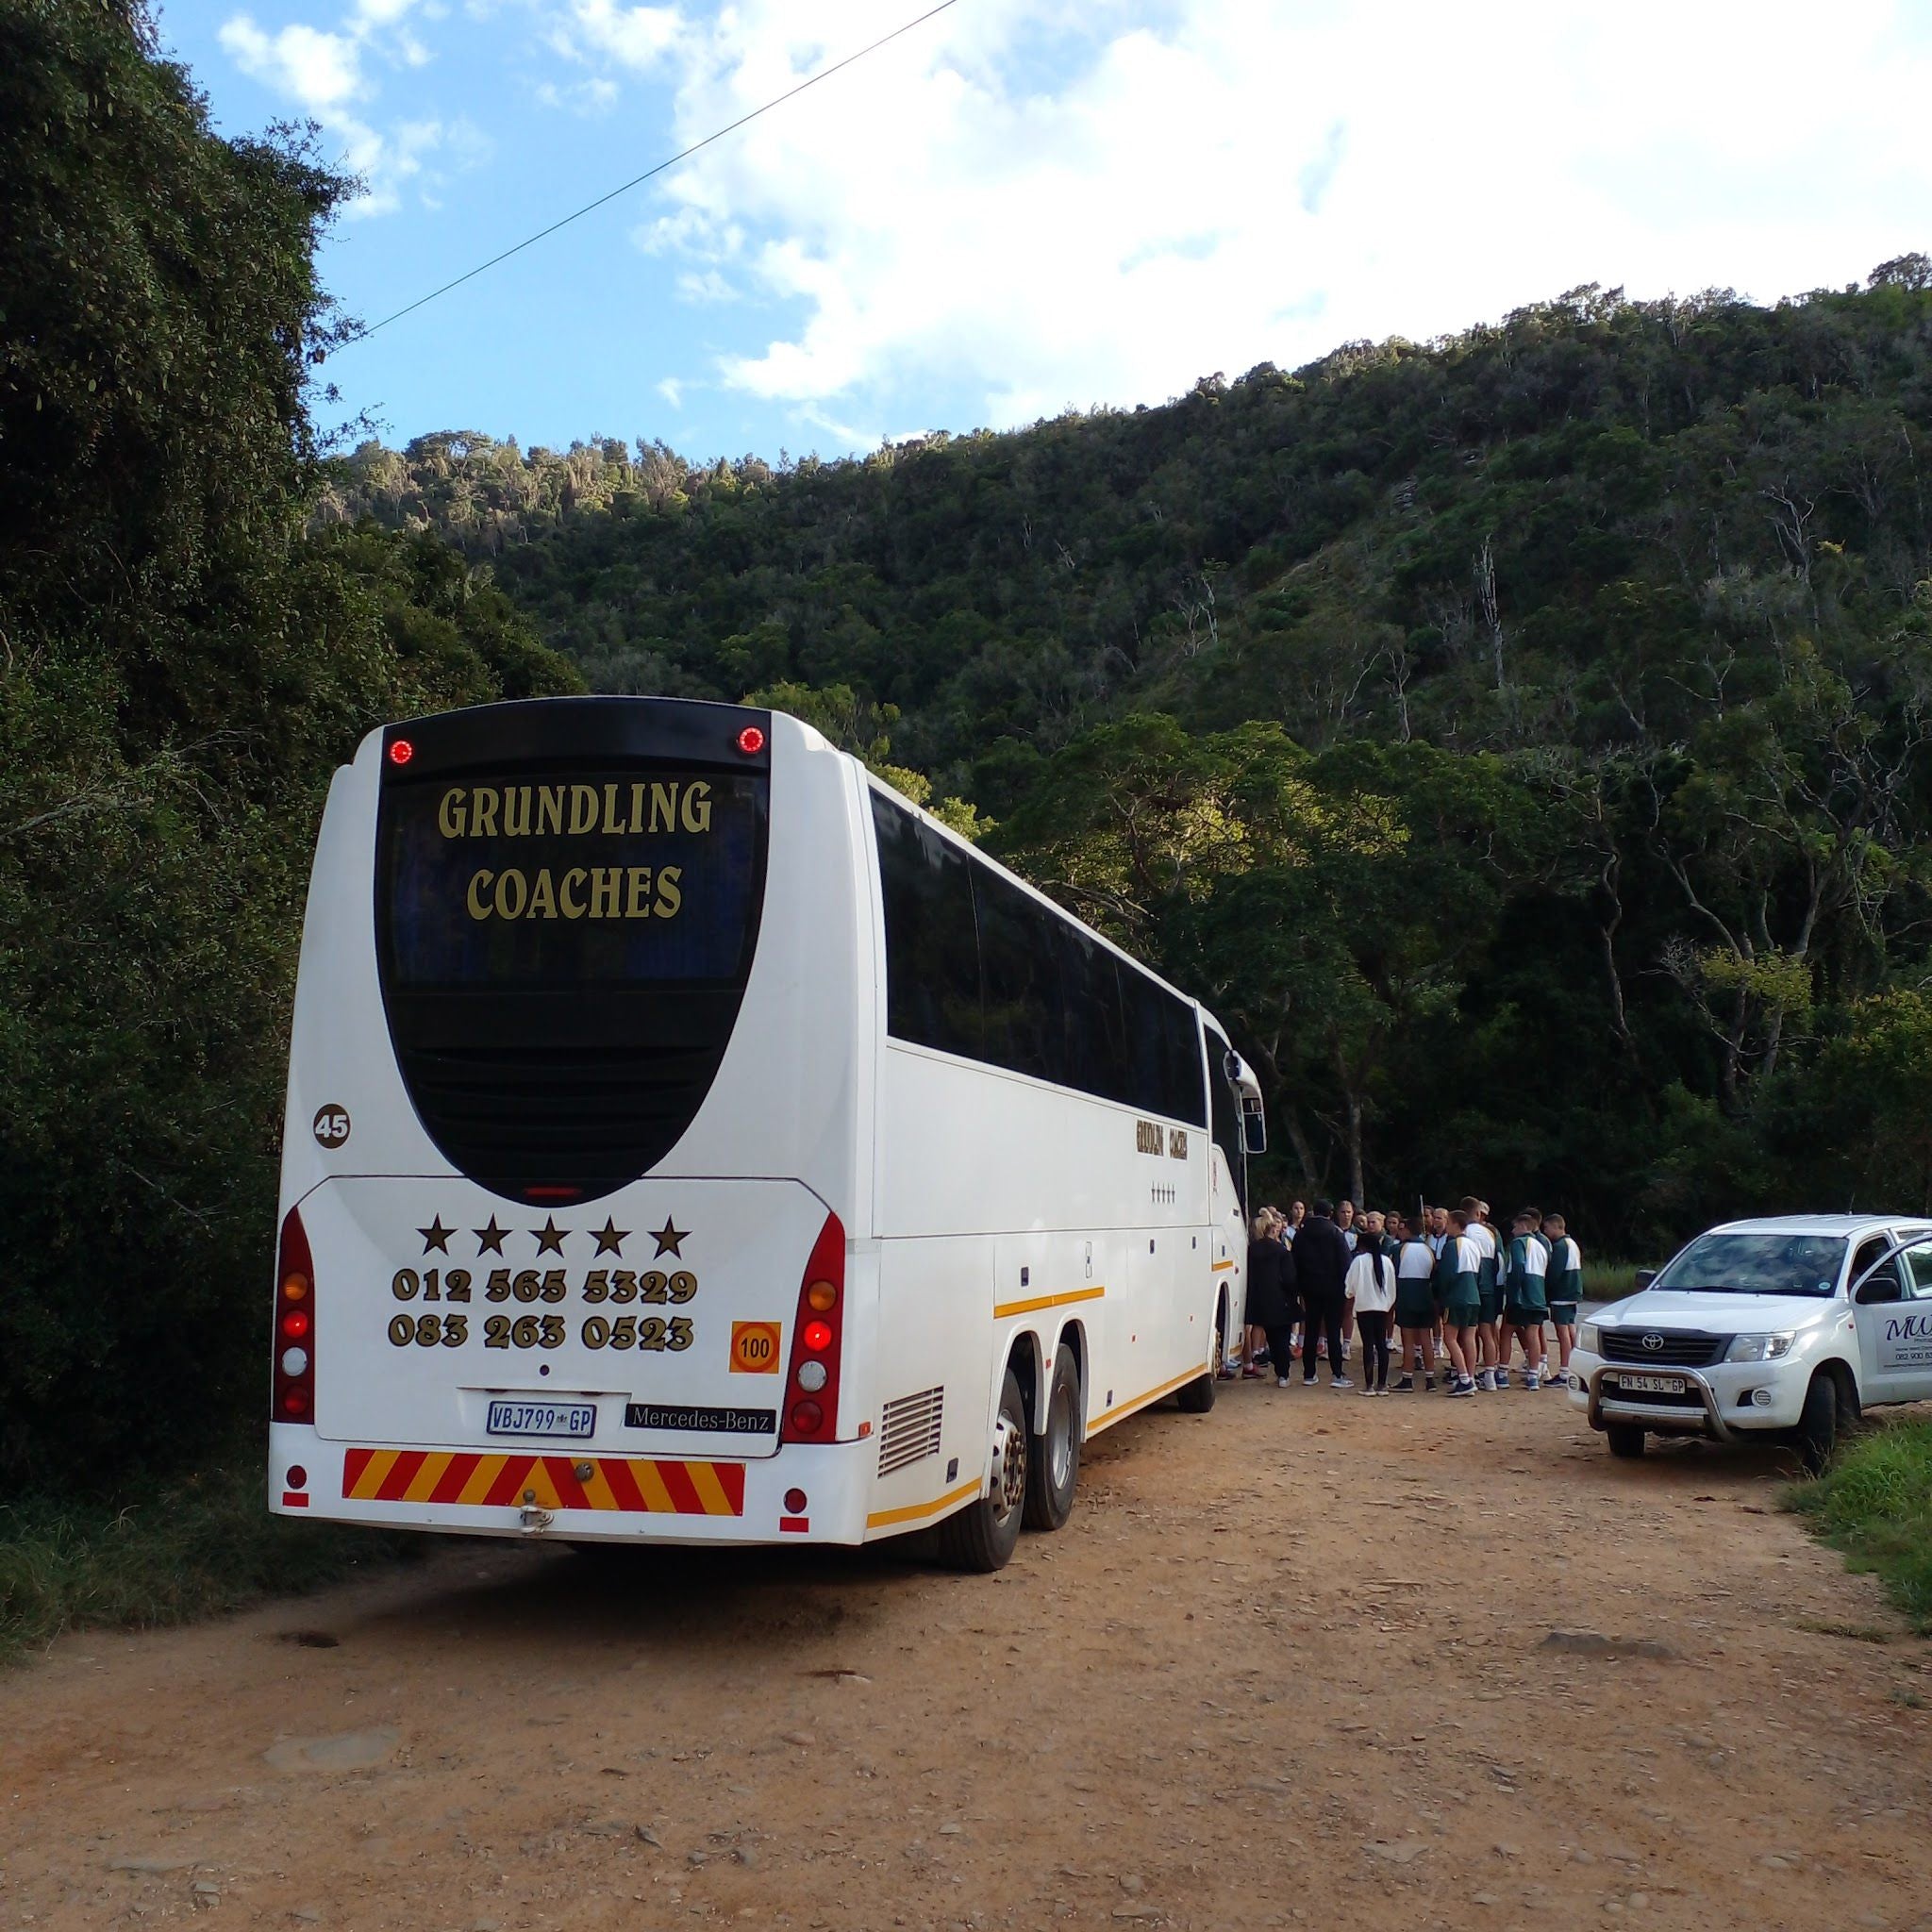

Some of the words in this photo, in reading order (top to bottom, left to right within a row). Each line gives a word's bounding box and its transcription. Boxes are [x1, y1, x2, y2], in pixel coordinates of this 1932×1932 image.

[438, 780, 712, 839] GRUNDLING
[466, 865, 682, 921] COACHES
[315, 1114, 348, 1138] 45
[391, 1268, 472, 1302] 012
[484, 1268, 567, 1303] 565
[581, 1269, 698, 1305] 5329
[388, 1314, 469, 1348] 083
[483, 1314, 566, 1349] 263
[581, 1316, 694, 1351] 0523
[741, 1337, 770, 1358] 100
[1622, 1375, 1633, 1388] FN
[1637, 1376, 1648, 1389] 54
[1653, 1378, 1664, 1391] SL
[1672, 1379, 1684, 1391] GP
[493, 1407, 555, 1430] VBJ799
[569, 1409, 591, 1431] GP
[633, 1407, 769, 1432] Mercedes-Benz
